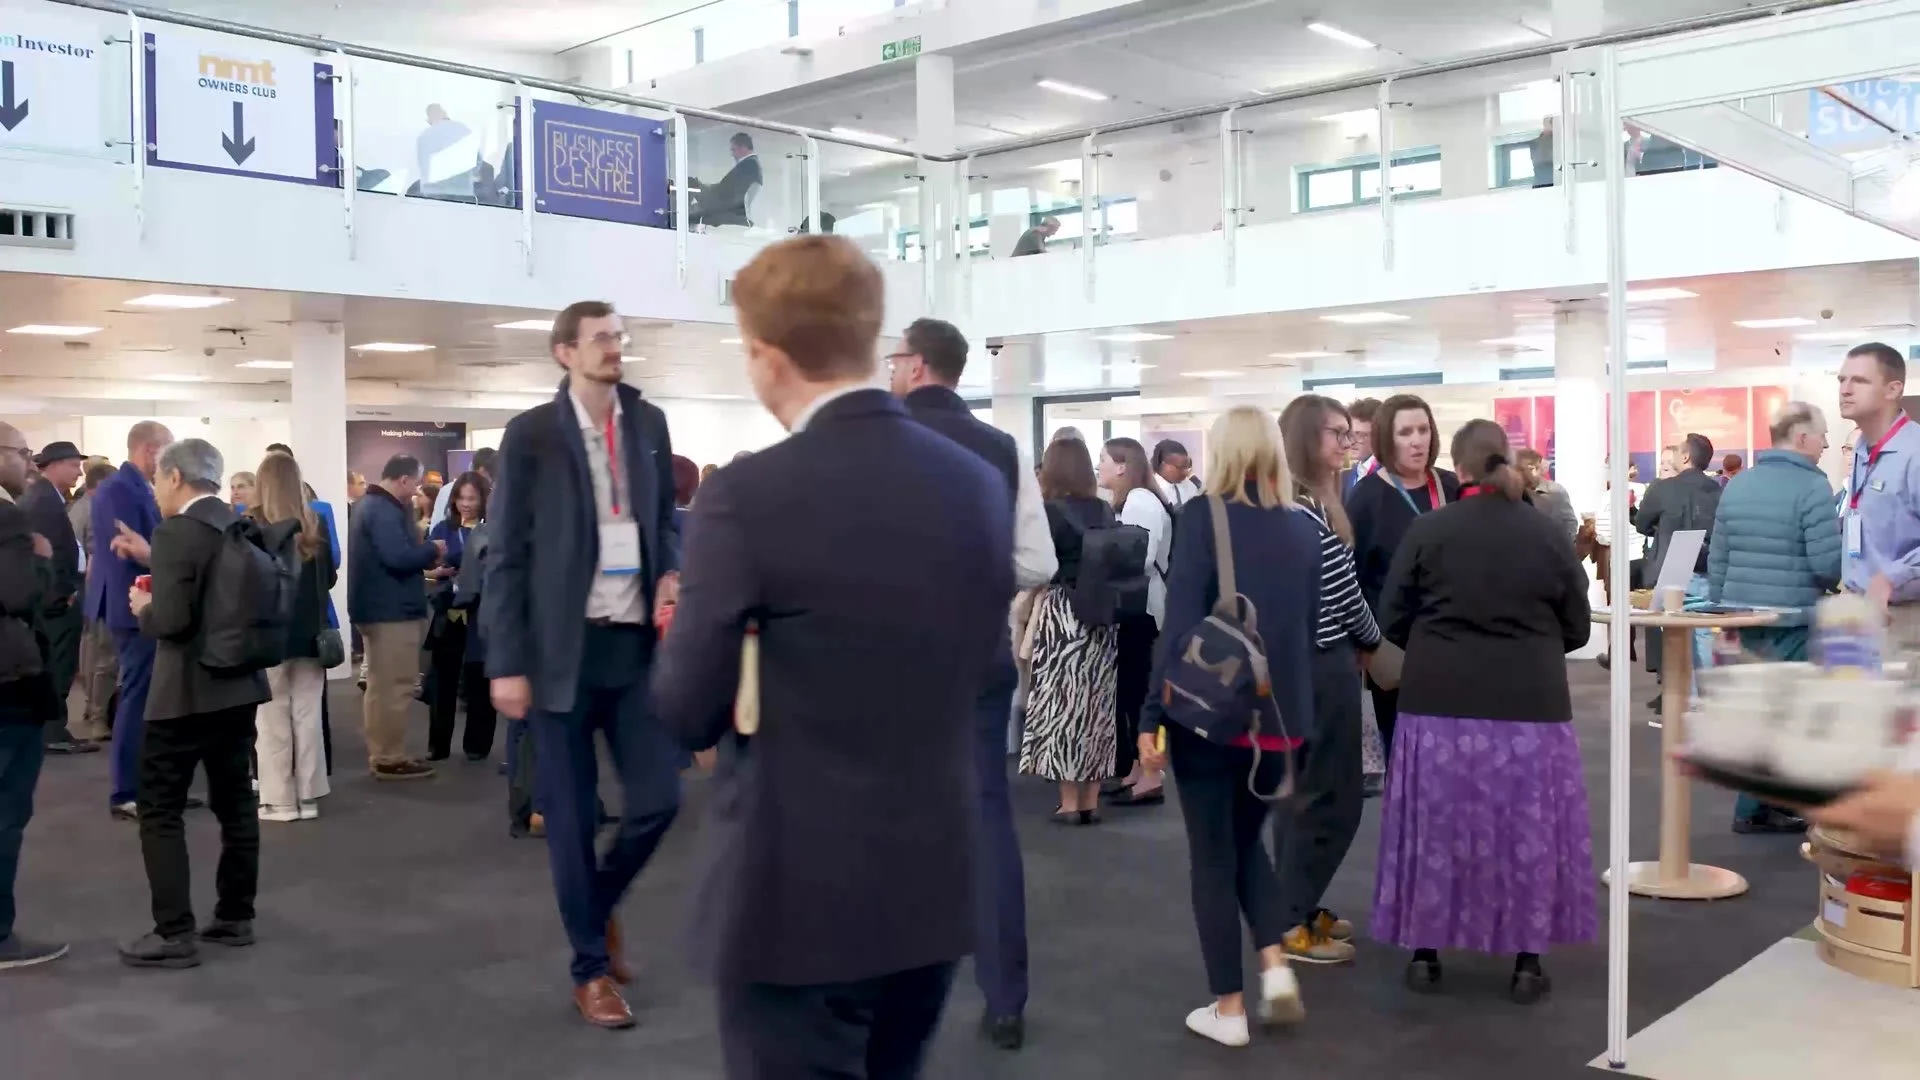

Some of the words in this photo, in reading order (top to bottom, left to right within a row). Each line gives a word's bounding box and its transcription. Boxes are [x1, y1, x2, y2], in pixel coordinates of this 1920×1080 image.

[0, 34, 94, 59] nInvestor
[198, 77, 249, 95] OWNERS
[252, 86, 277, 99] CLUB
[1815, 95, 1920, 134] SUM
[553, 131, 634, 160] BUSINESS
[553, 143, 634, 175] DESIGN
[553, 165, 634, 195] CENTRE
